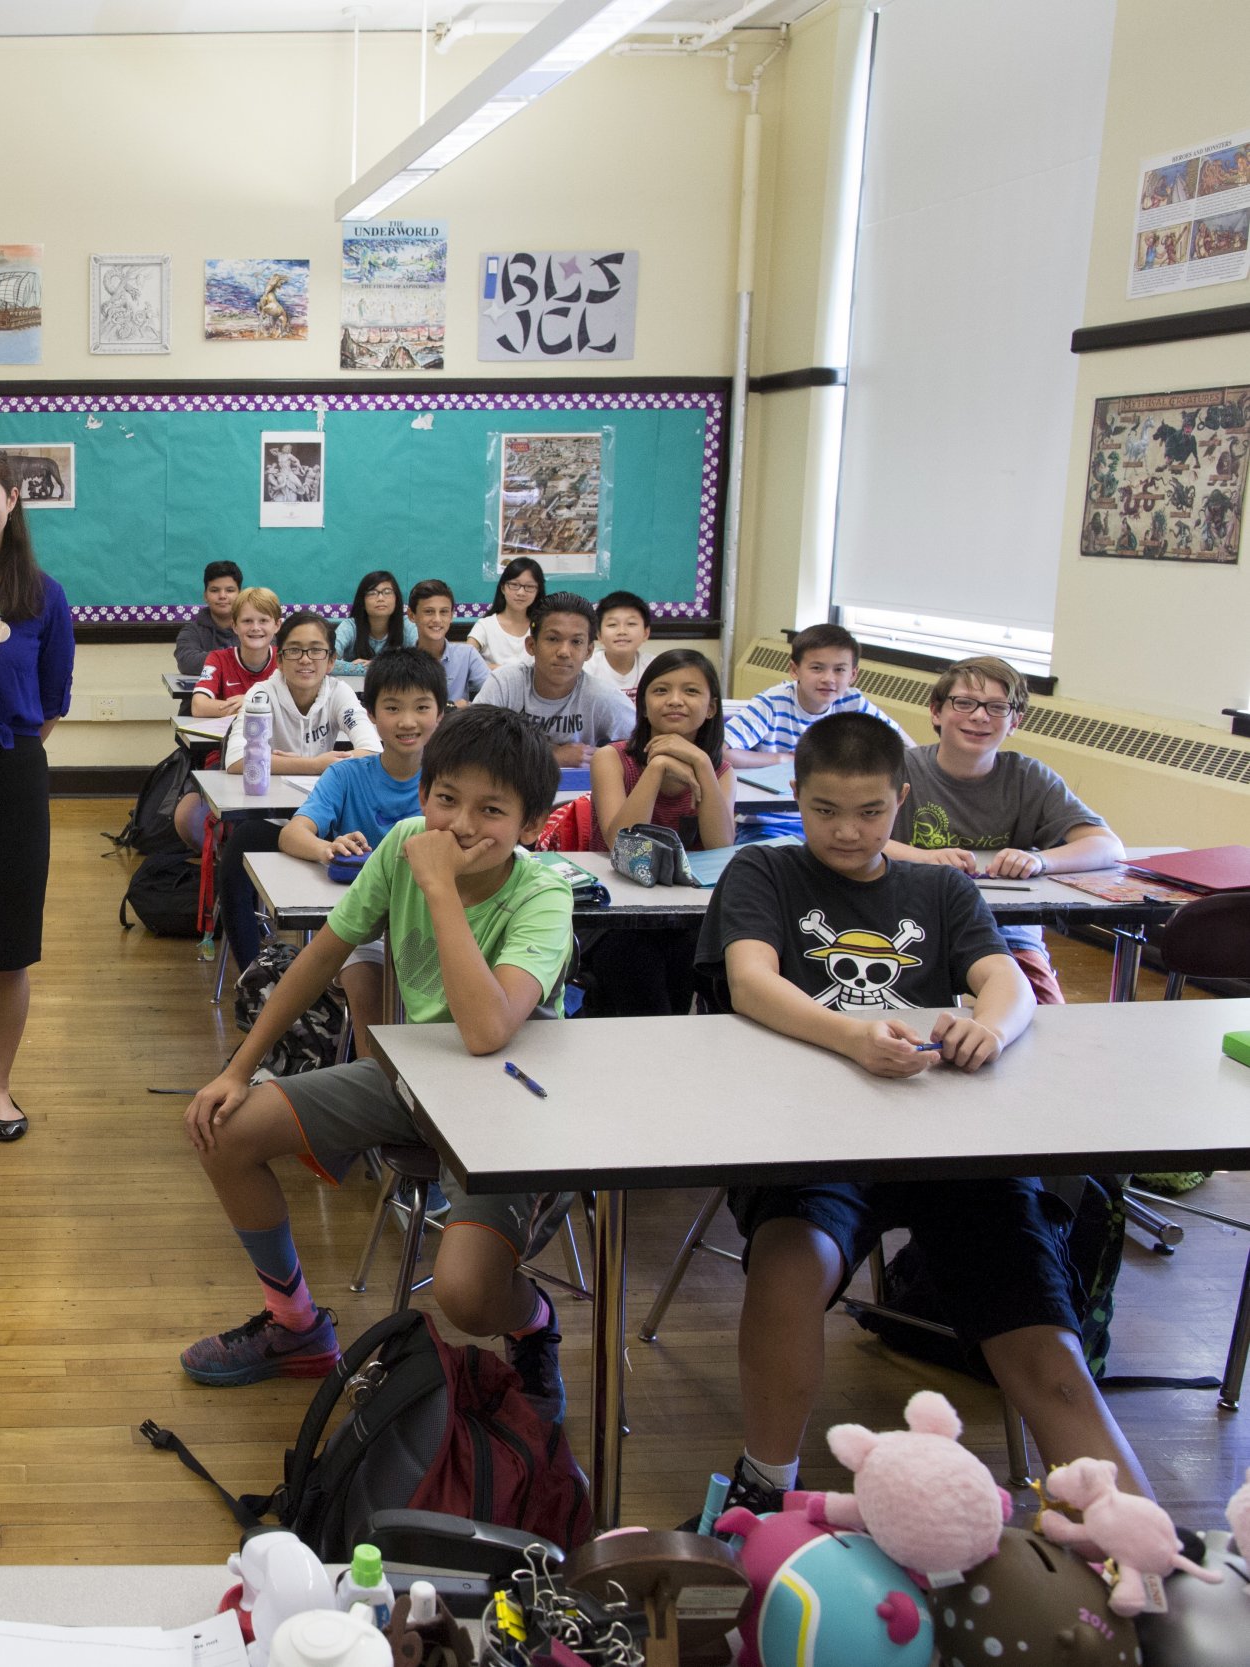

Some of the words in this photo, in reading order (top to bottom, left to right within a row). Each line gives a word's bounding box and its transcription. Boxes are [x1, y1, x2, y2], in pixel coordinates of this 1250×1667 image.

[1193, 148, 1204, 157] AND
[354, 227, 439, 237] UNDERWORLD
[501, 252, 625, 306] BLS
[496, 306, 617, 355] JCL
[1169, 392, 1220, 407] CREATURES
[1078, 1606, 1115, 1640] 2011
